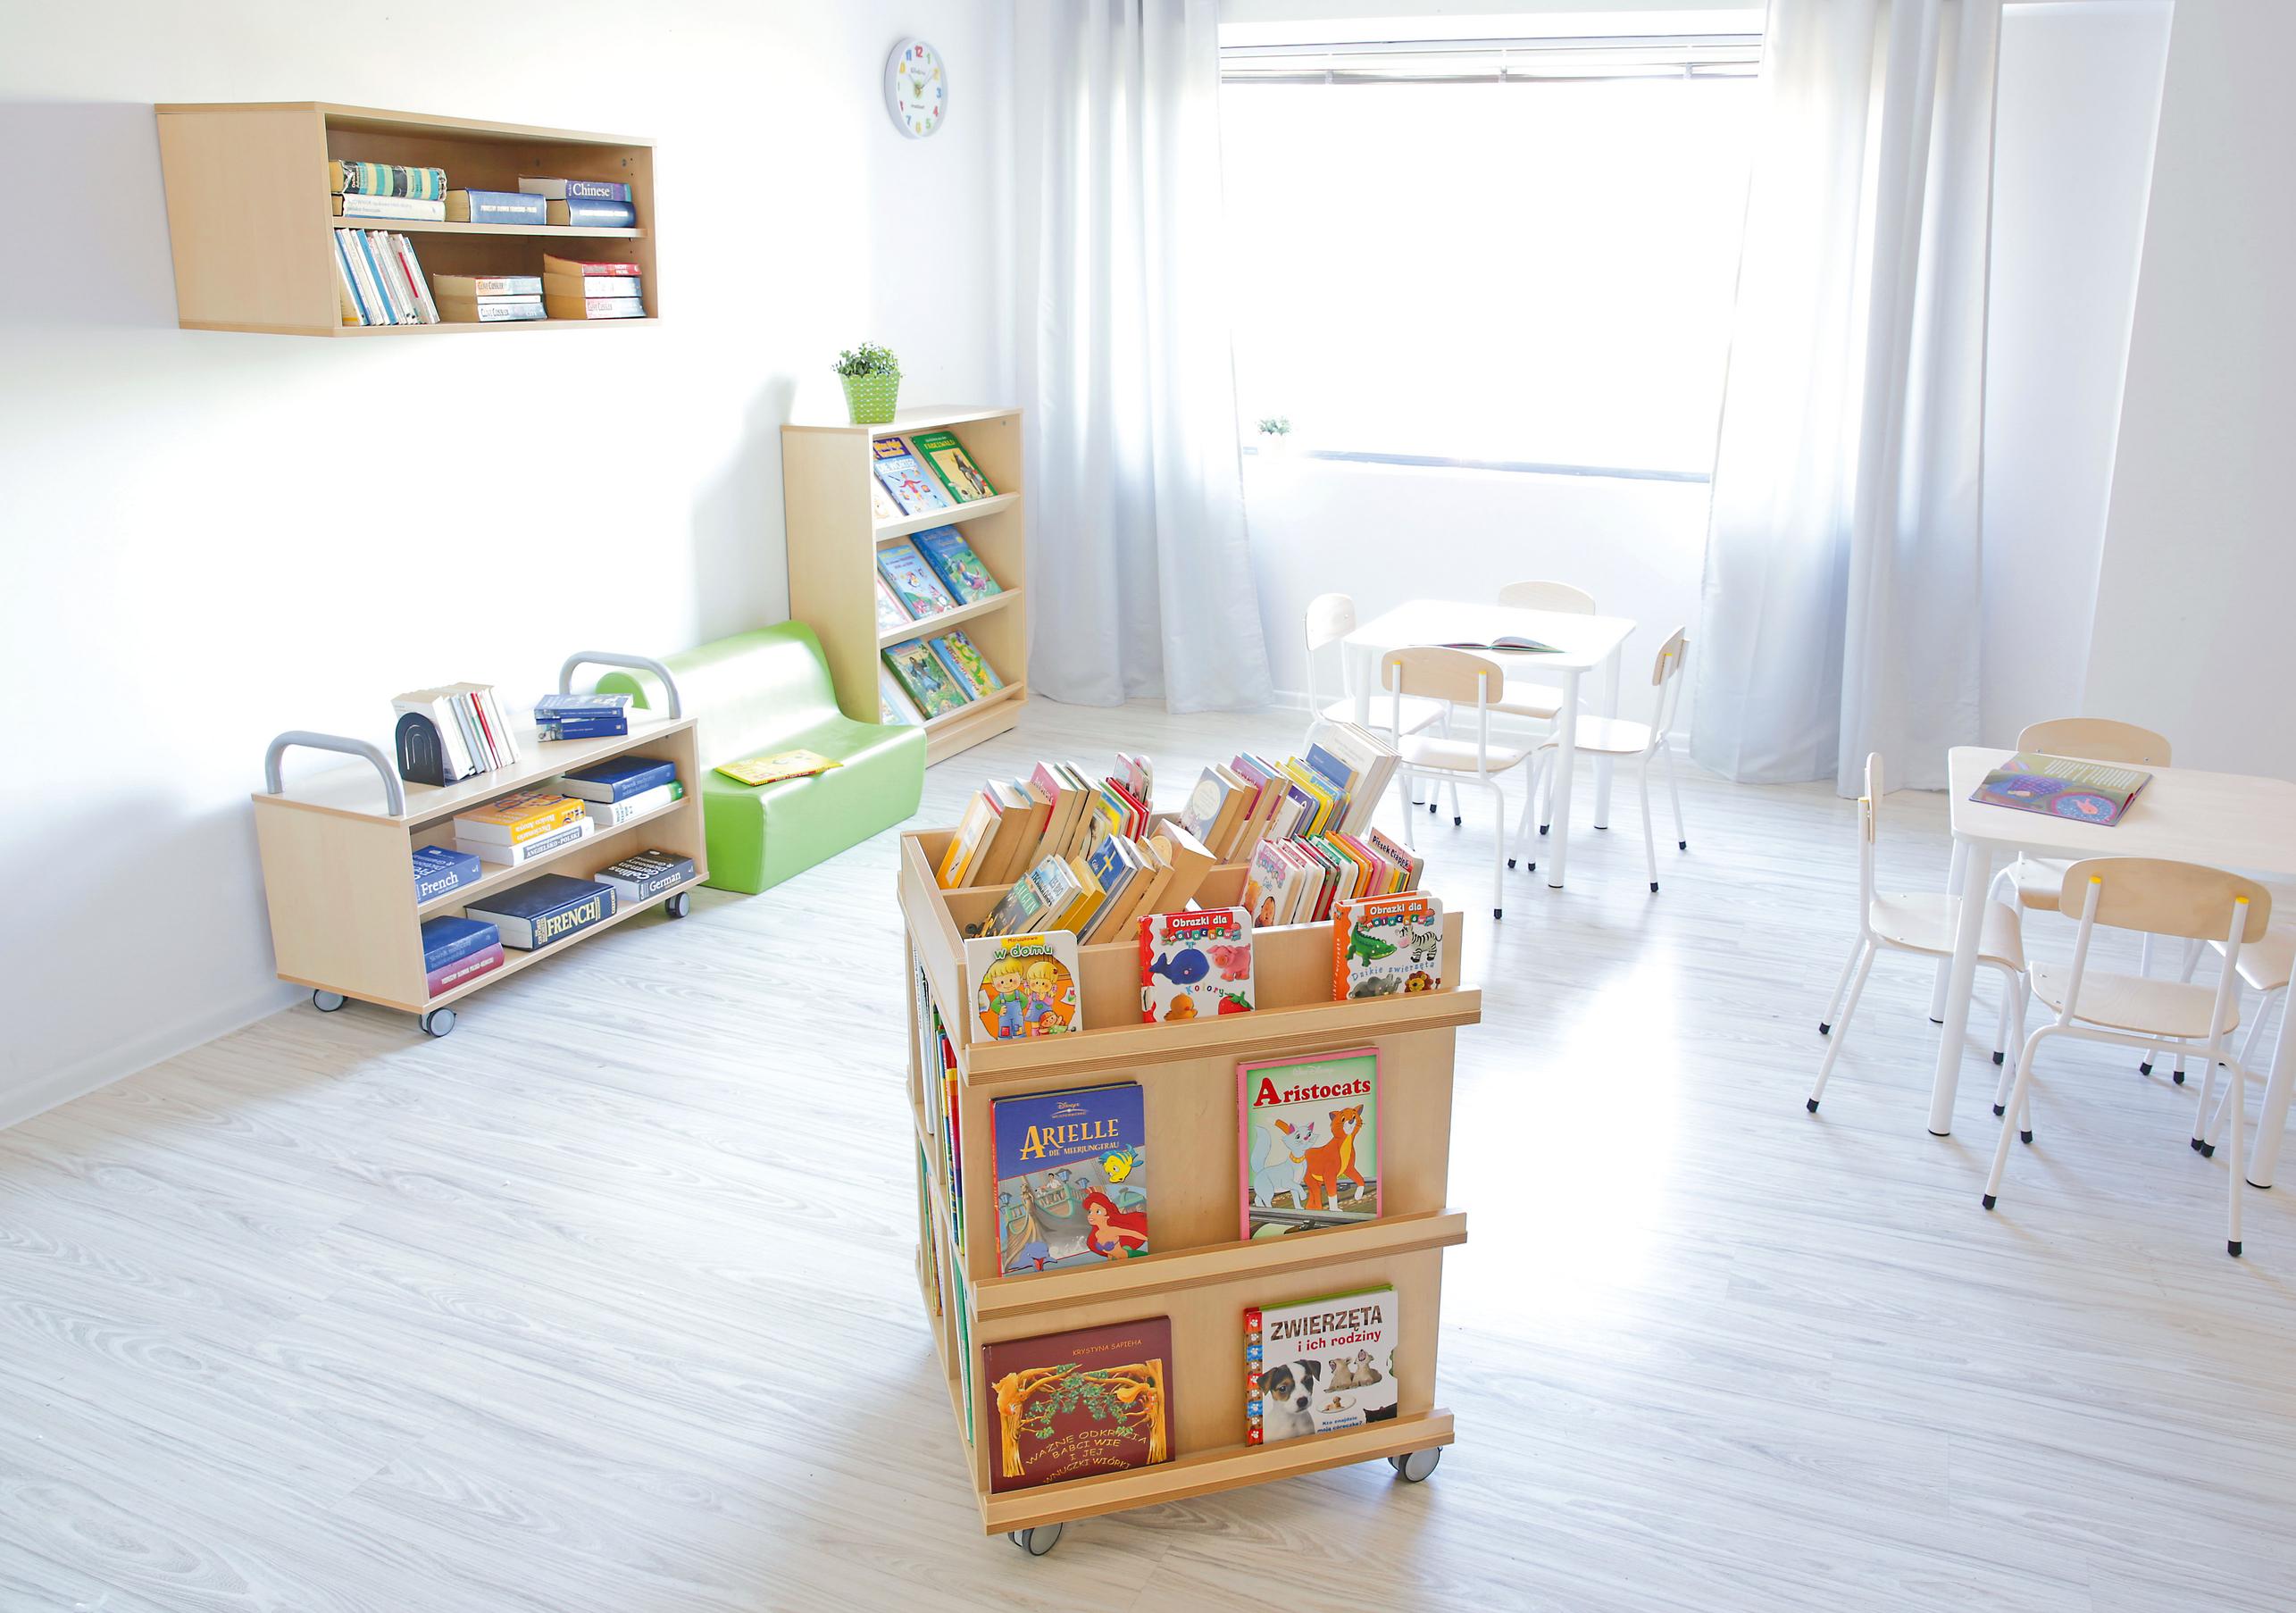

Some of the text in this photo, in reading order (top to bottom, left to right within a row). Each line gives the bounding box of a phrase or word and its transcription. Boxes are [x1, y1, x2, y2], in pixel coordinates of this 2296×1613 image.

[914, 46, 923, 57] 12
[936, 88, 942, 98] 3
[933, 105, 939, 117] 4
[572, 183, 610, 196] Chinese
[1372, 835, 1409, 868] Piesek Ciapek
[608, 865, 649, 880] Collins
[618, 862, 659, 875] German
[421, 871, 459, 896] French
[649, 872, 681, 891] German
[1370, 903, 1422, 915] Obrazki dla
[547, 901, 596, 937] FRENCH
[1172, 915, 1228, 928] Obrazki dla
[1366, 915, 1426, 928] maluchów
[1170, 929, 1231, 941] maluchów
[994, 944, 1052, 959] w domu
[1351, 961, 1435, 981] Dzikie zwierzęta
[1185, 982, 1225, 997] Kolory
[1253, 1077, 1371, 1107] Aristocats
[1020, 1118, 1119, 1160] ARIELLE
[1048, 1141, 1120, 1158] DIE MEERJUNGFRAU
[1270, 1305, 1383, 1341] ZWIERZĘTA
[1073, 1339, 1142, 1357] KRYSTYNA SAPIEHA
[1298, 1330, 1382, 1352] i ich rodziny
[1334, 1417, 1358, 1425] znajdzie
[1079, 1429, 1147, 1444] ODKRYCIA
[1052, 1439, 1122, 1459] BABCI WIE
[1082, 1448, 1104, 1458] JEJ
[1043, 1457, 1131, 1483] WNUCZKI WIÓRKI
